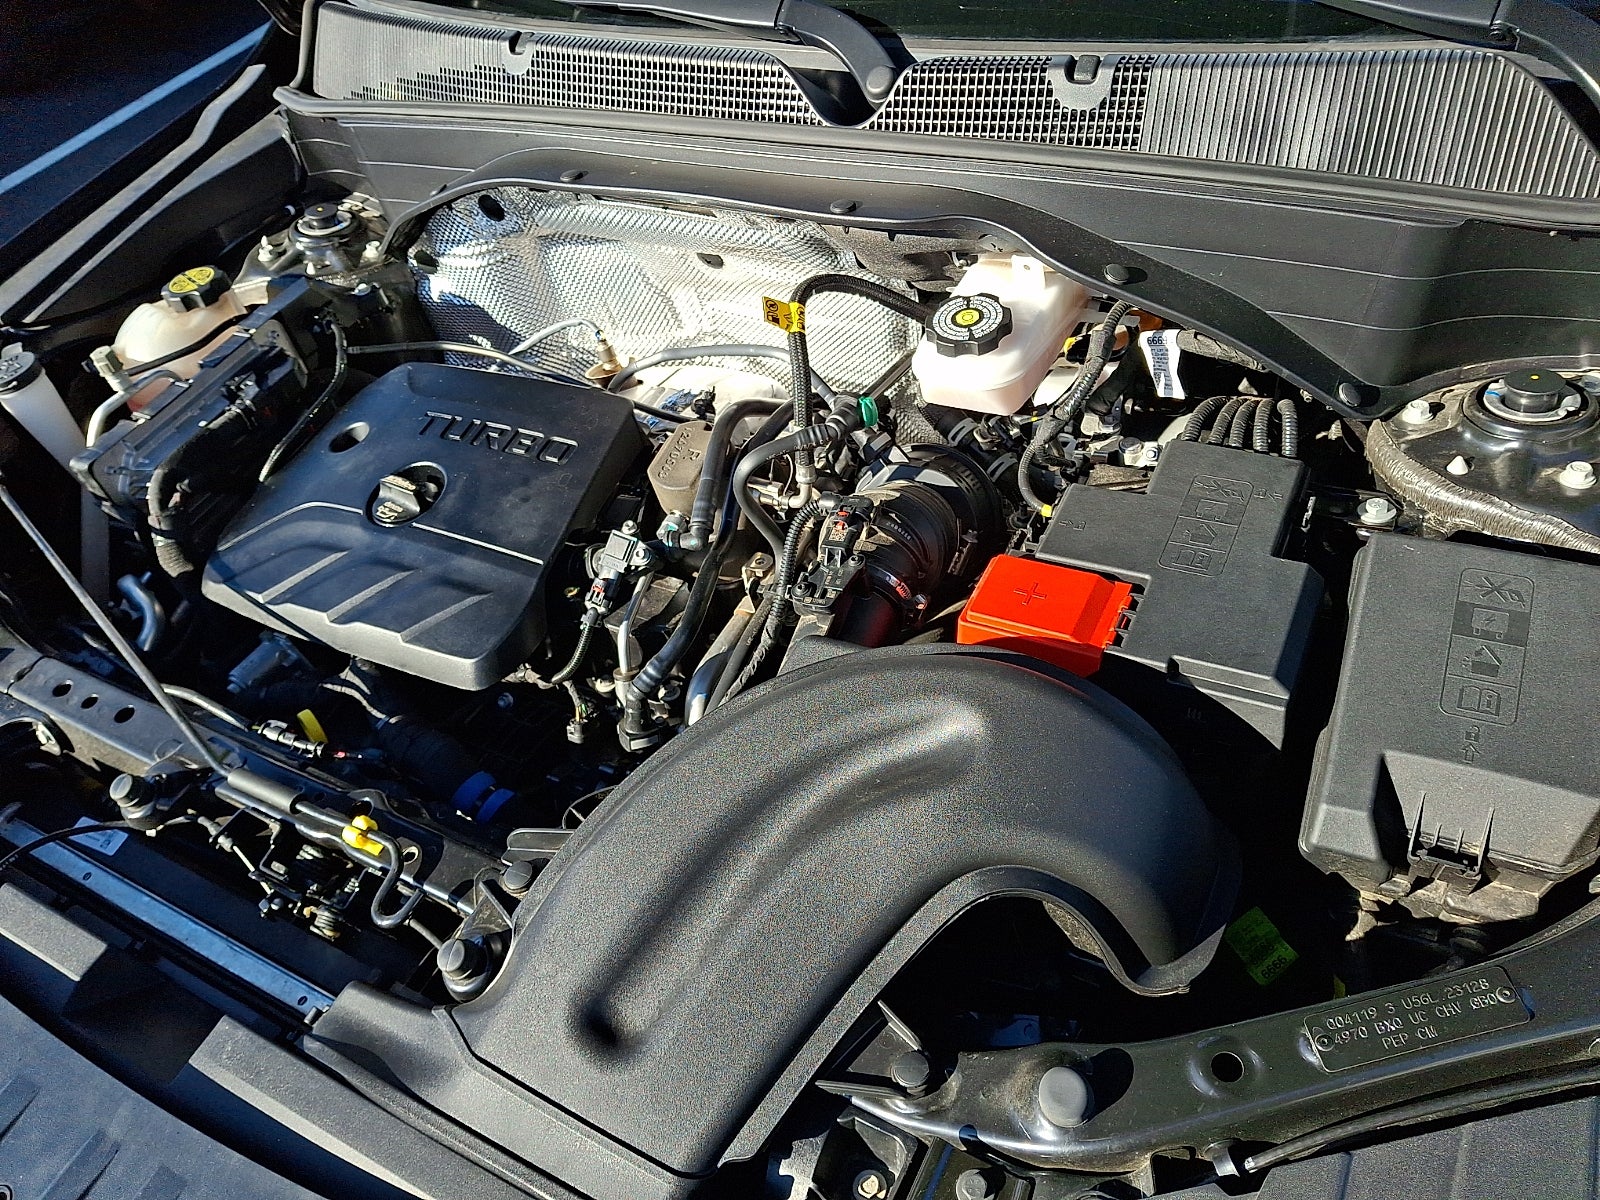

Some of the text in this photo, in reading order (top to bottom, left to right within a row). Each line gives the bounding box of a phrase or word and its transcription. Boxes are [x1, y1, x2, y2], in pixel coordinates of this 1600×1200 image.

[419, 410, 579, 466] TURBO
[1408, 1010, 1429, 1025] UC
[1382, 1032, 1409, 1050] PEP
